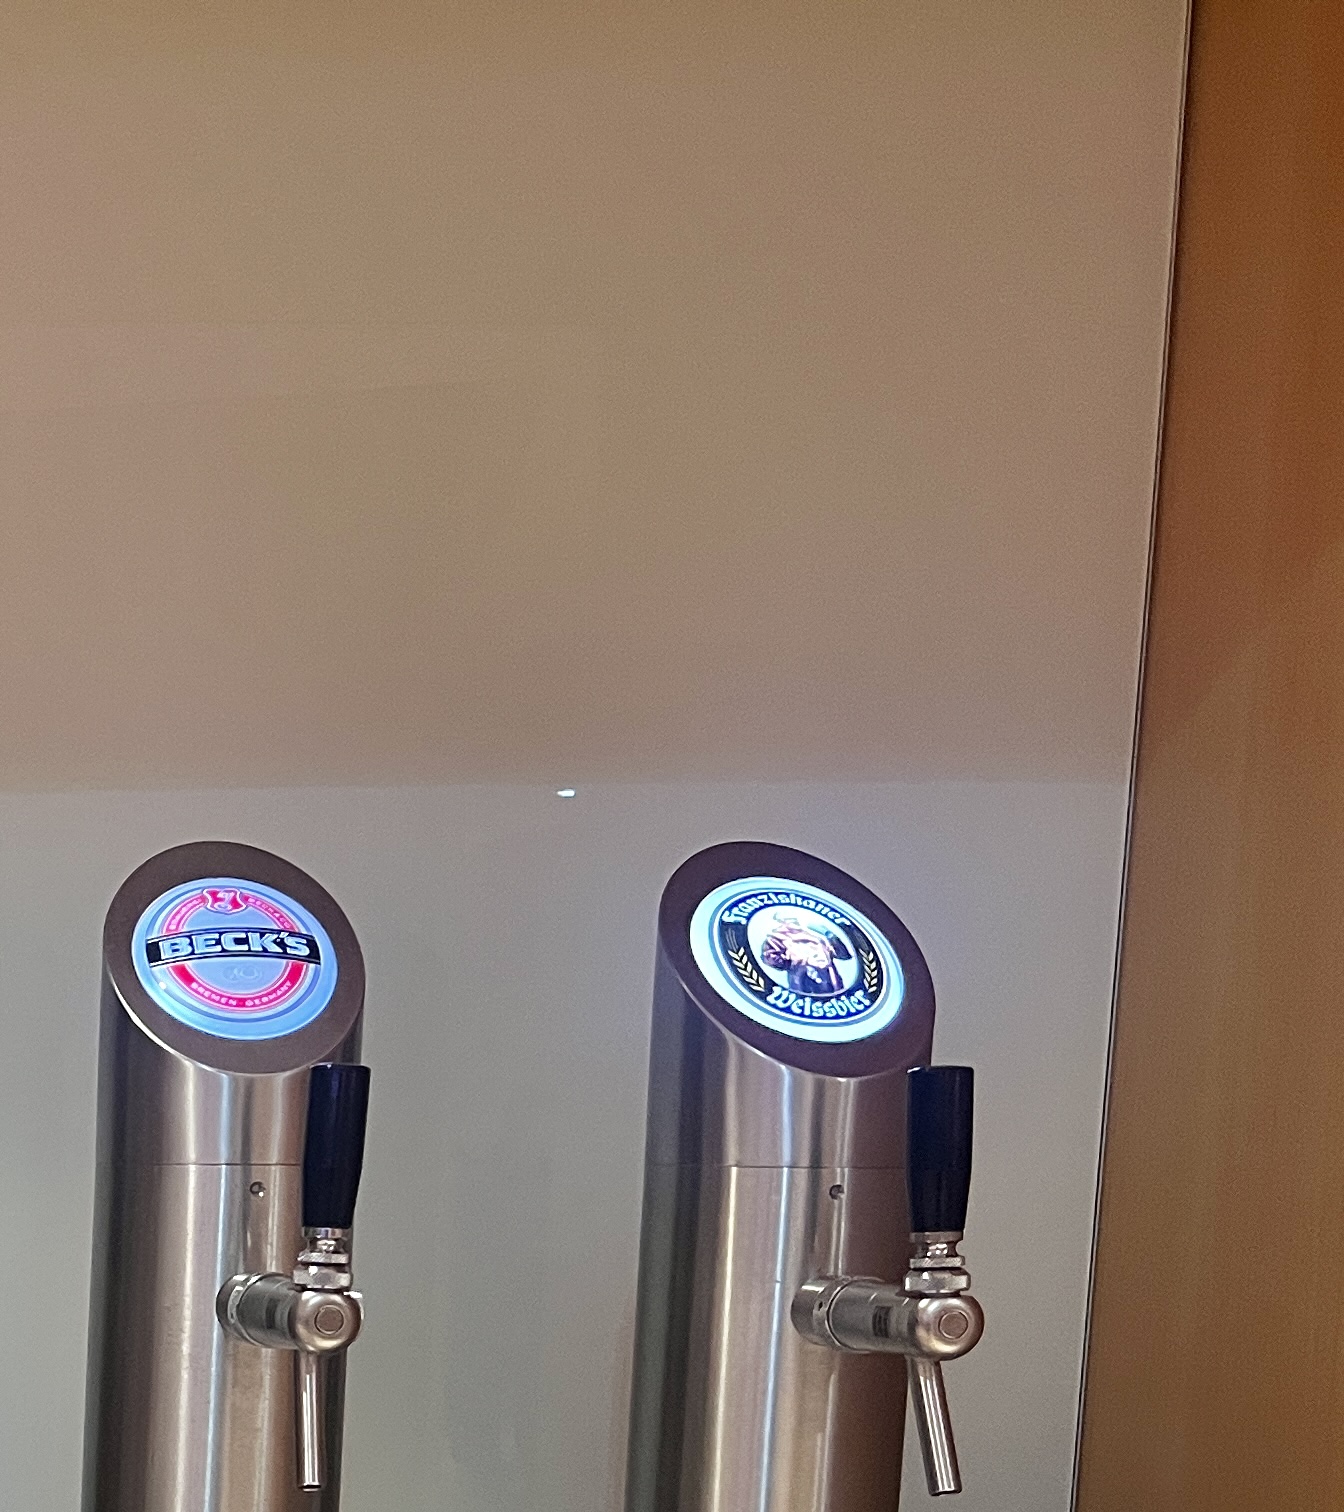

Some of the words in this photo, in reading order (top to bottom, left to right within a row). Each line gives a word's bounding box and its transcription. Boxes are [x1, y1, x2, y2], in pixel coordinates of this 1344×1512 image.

[721, 893, 853, 926] Franziskaner
[159, 931, 311, 960] BECK'S
[190, 981, 238, 1007] BREMEN
[244, 981, 292, 1007] GERMANY
[766, 985, 870, 1018] Weissbier
